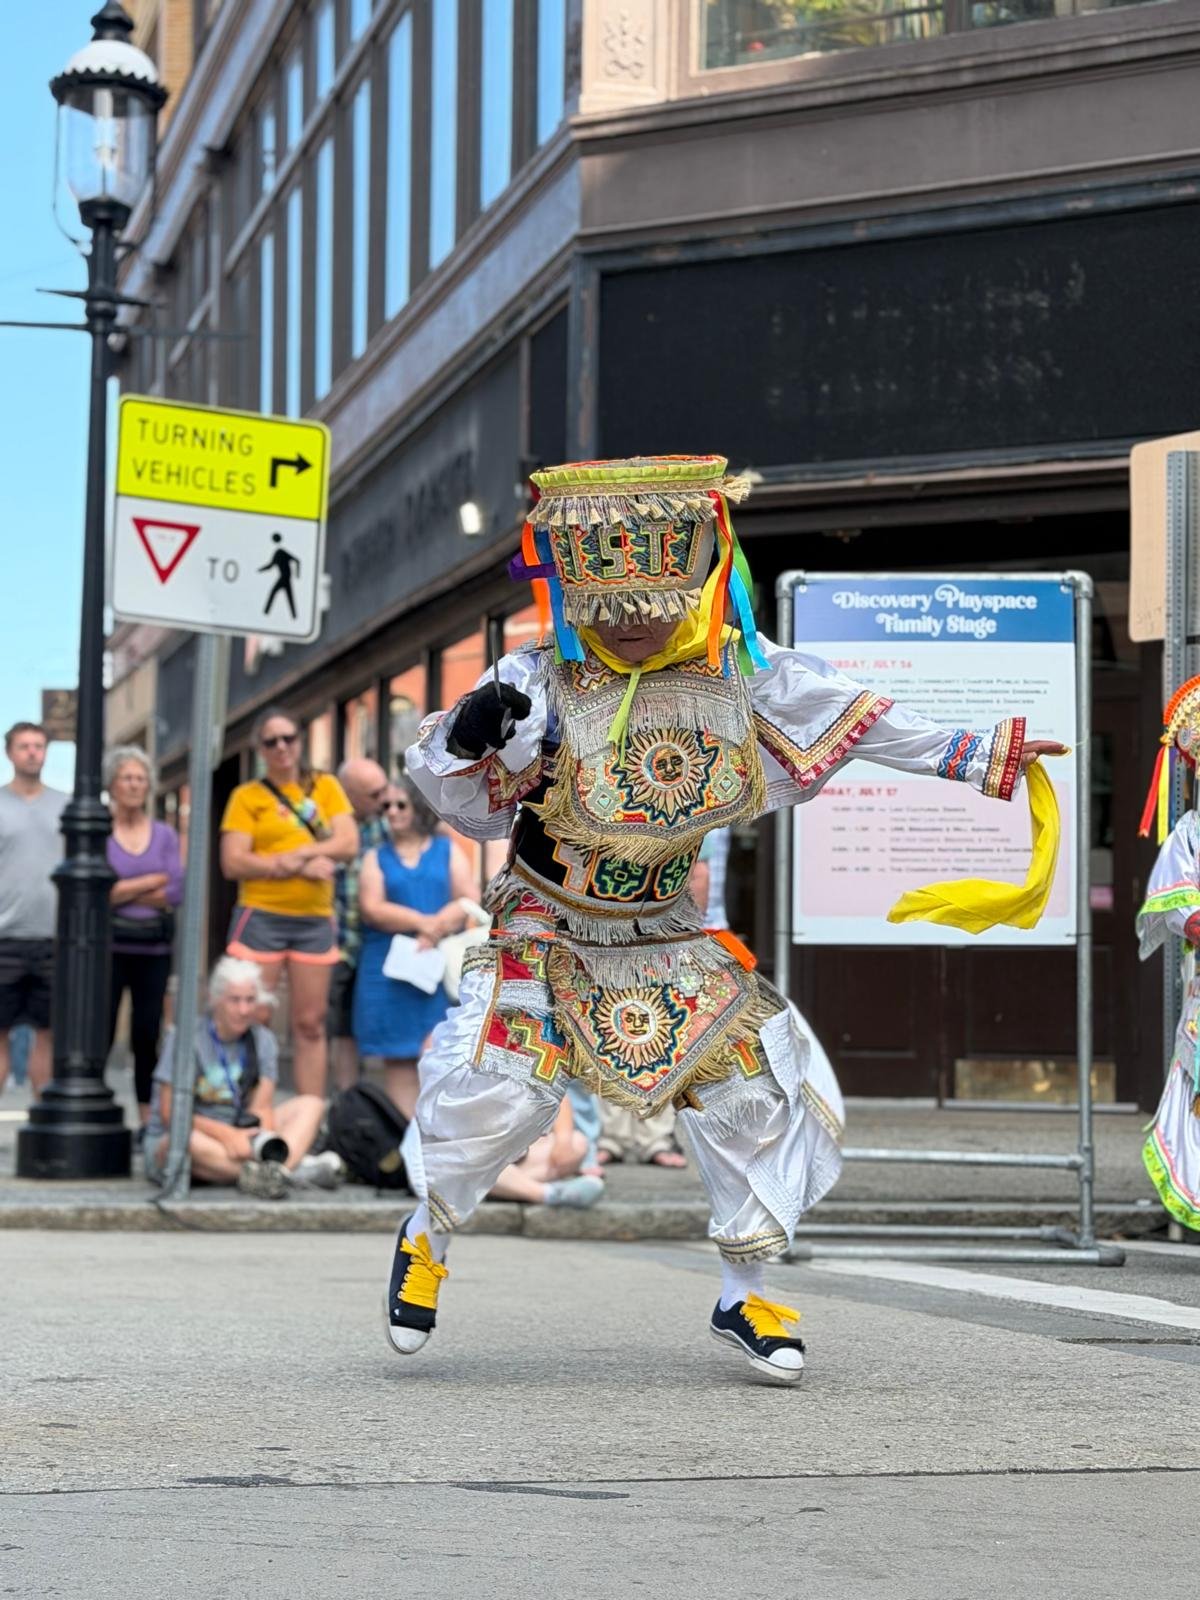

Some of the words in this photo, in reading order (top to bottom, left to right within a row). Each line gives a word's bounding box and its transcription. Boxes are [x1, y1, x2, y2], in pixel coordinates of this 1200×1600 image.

[137, 418, 254, 456] TURNING
[132, 458, 256, 496] VEHICLES
[208, 557, 240, 583] TO
[832, 591, 932, 612] Discovery
[935, 584, 1037, 613] Playspace
[876, 612, 944, 637] Family
[946, 614, 997, 639] Stage
